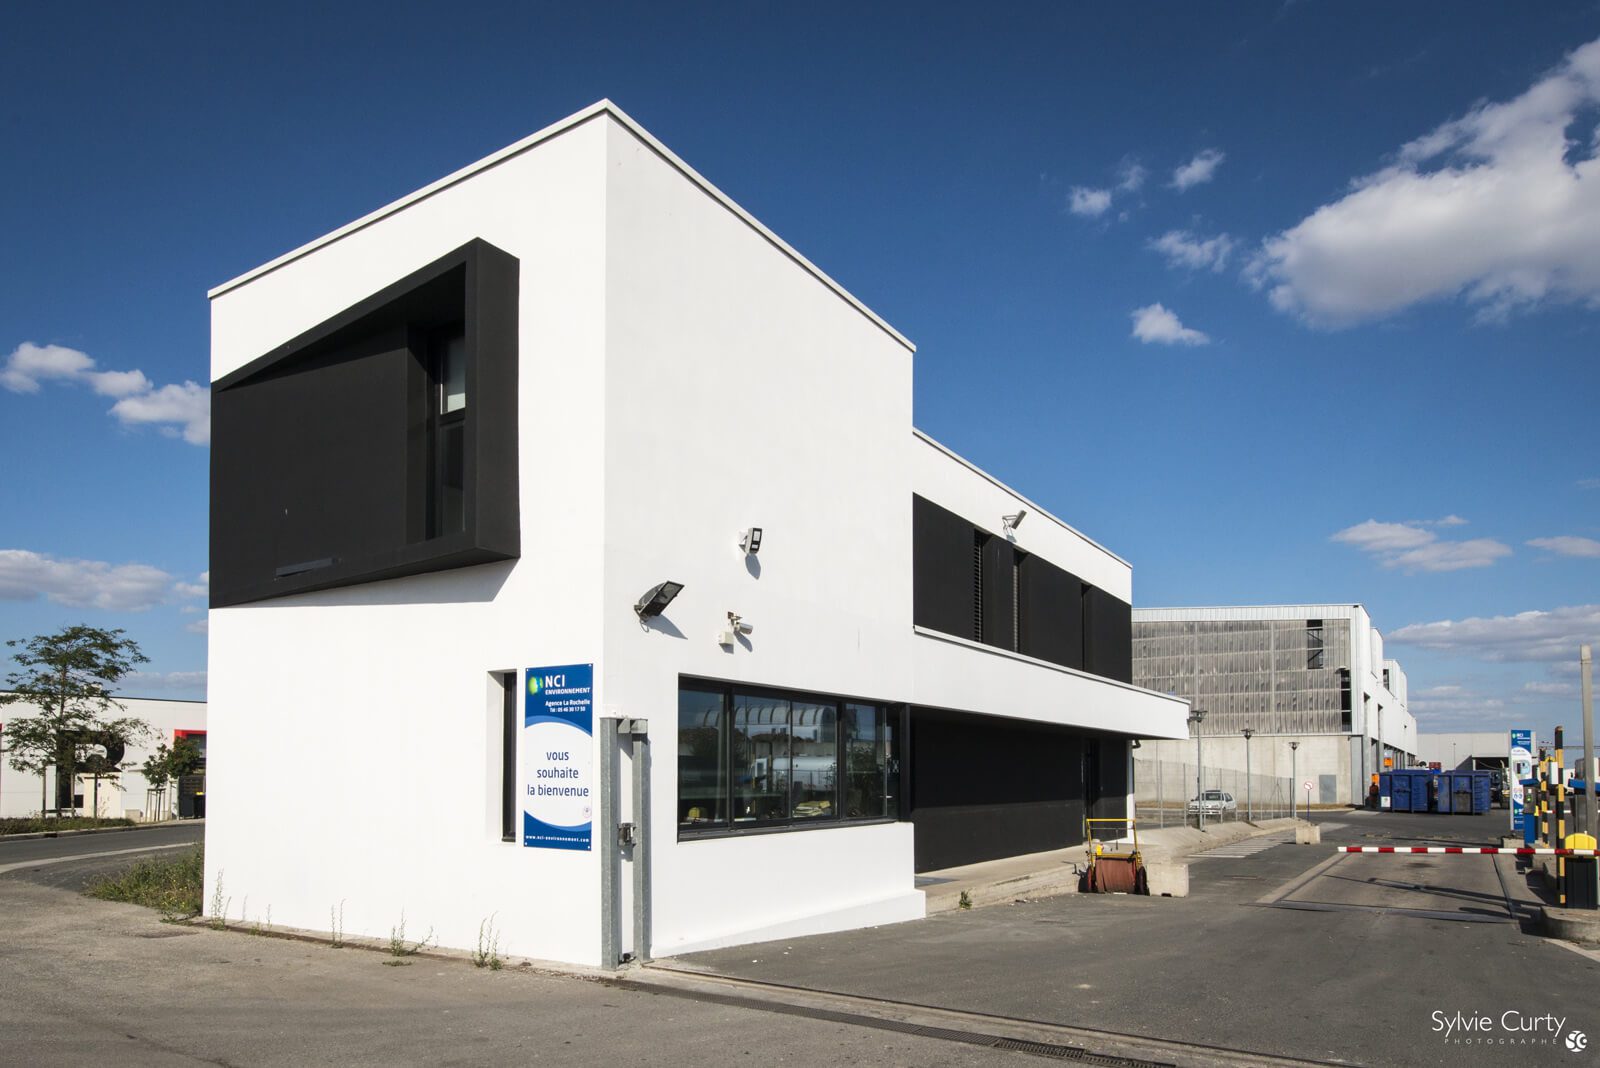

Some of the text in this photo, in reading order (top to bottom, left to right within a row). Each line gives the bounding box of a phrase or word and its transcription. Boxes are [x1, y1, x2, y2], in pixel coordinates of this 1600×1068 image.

[545, 675, 565, 688] NCI
[546, 752, 569, 760] vous
[537, 767, 579, 778] souhaite
[527, 784, 589, 797] la bienvenue
